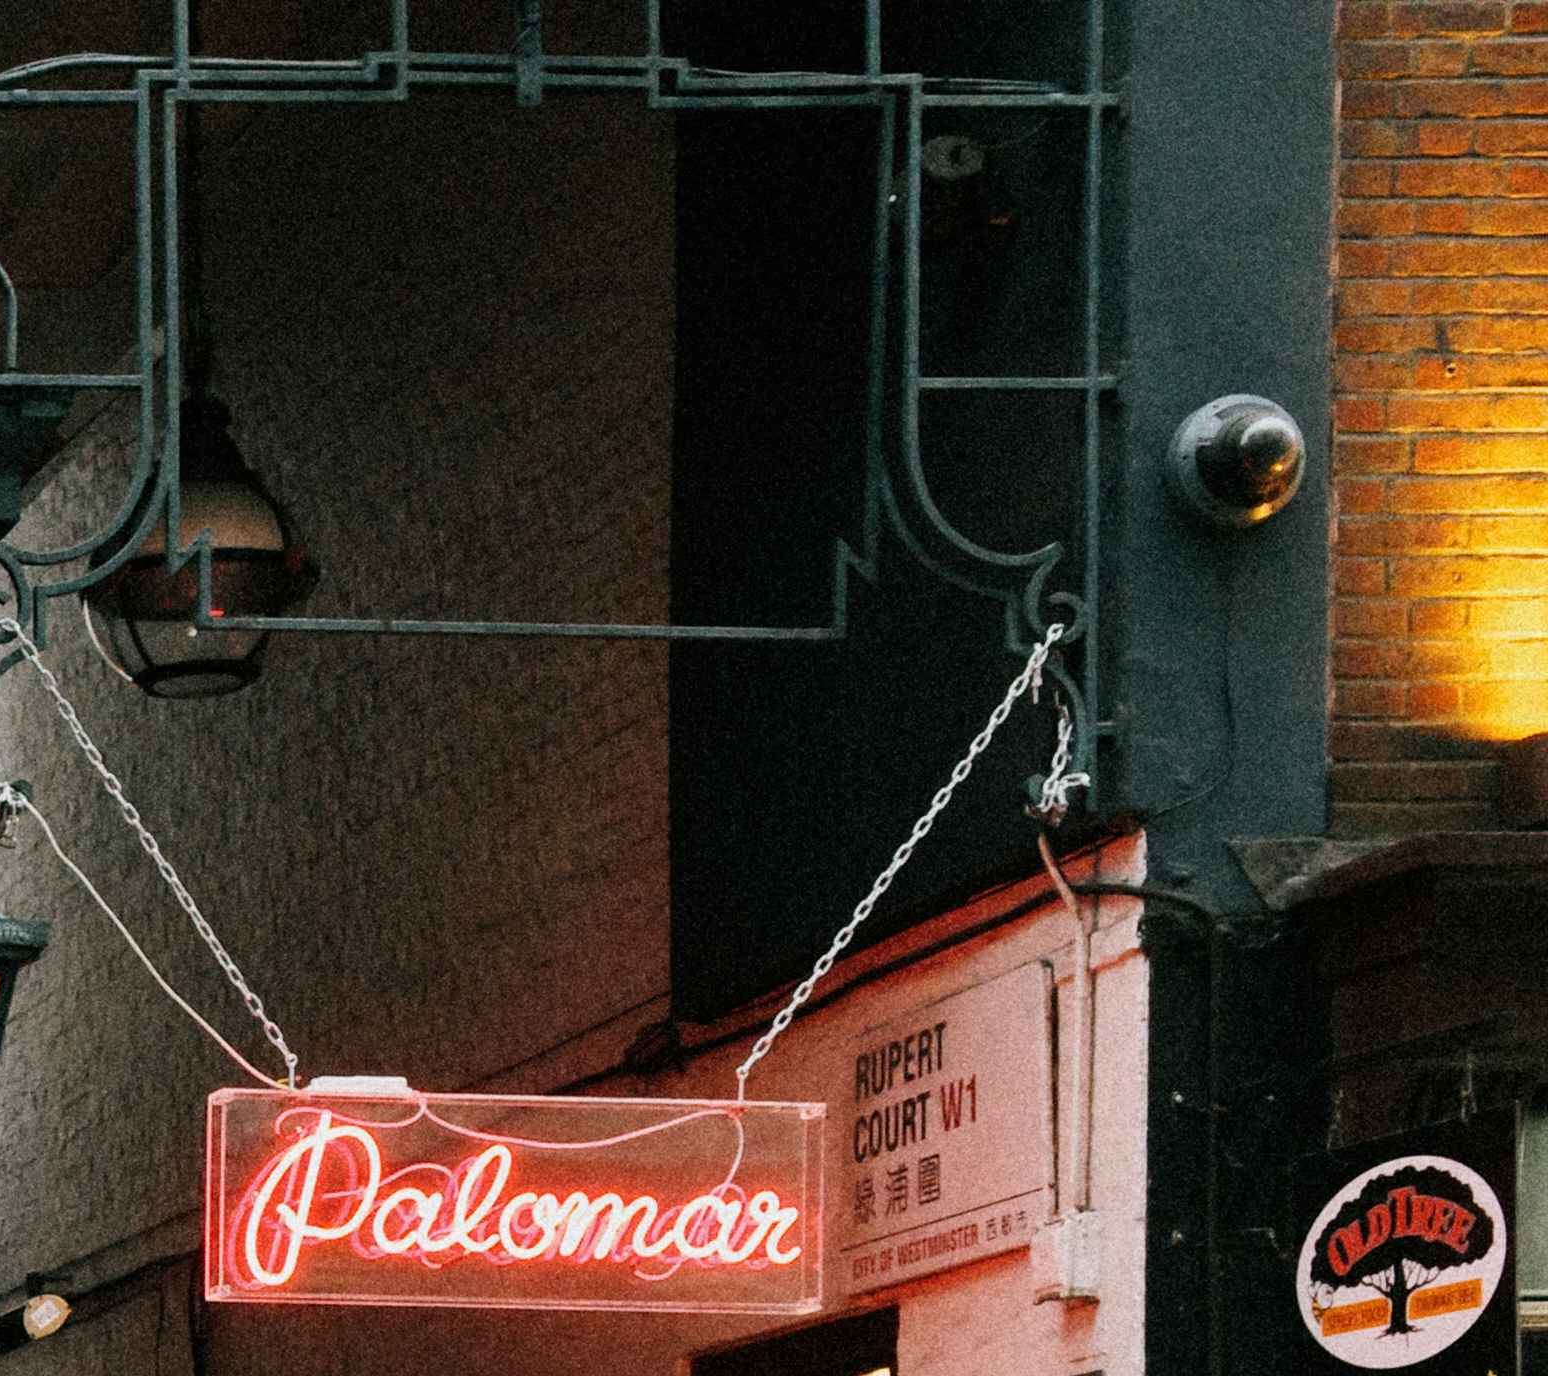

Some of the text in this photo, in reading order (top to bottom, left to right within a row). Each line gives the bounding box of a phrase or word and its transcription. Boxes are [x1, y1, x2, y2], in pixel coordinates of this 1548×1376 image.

[855, 1020, 947, 1101] RUPERT
[854, 1073, 977, 1164] COURT W1
[244, 1108, 802, 1286] Palomar
[1327, 1185, 1477, 1277] OLD TREE
[852, 1224, 979, 1279] CITY OF WESTMINSTER
